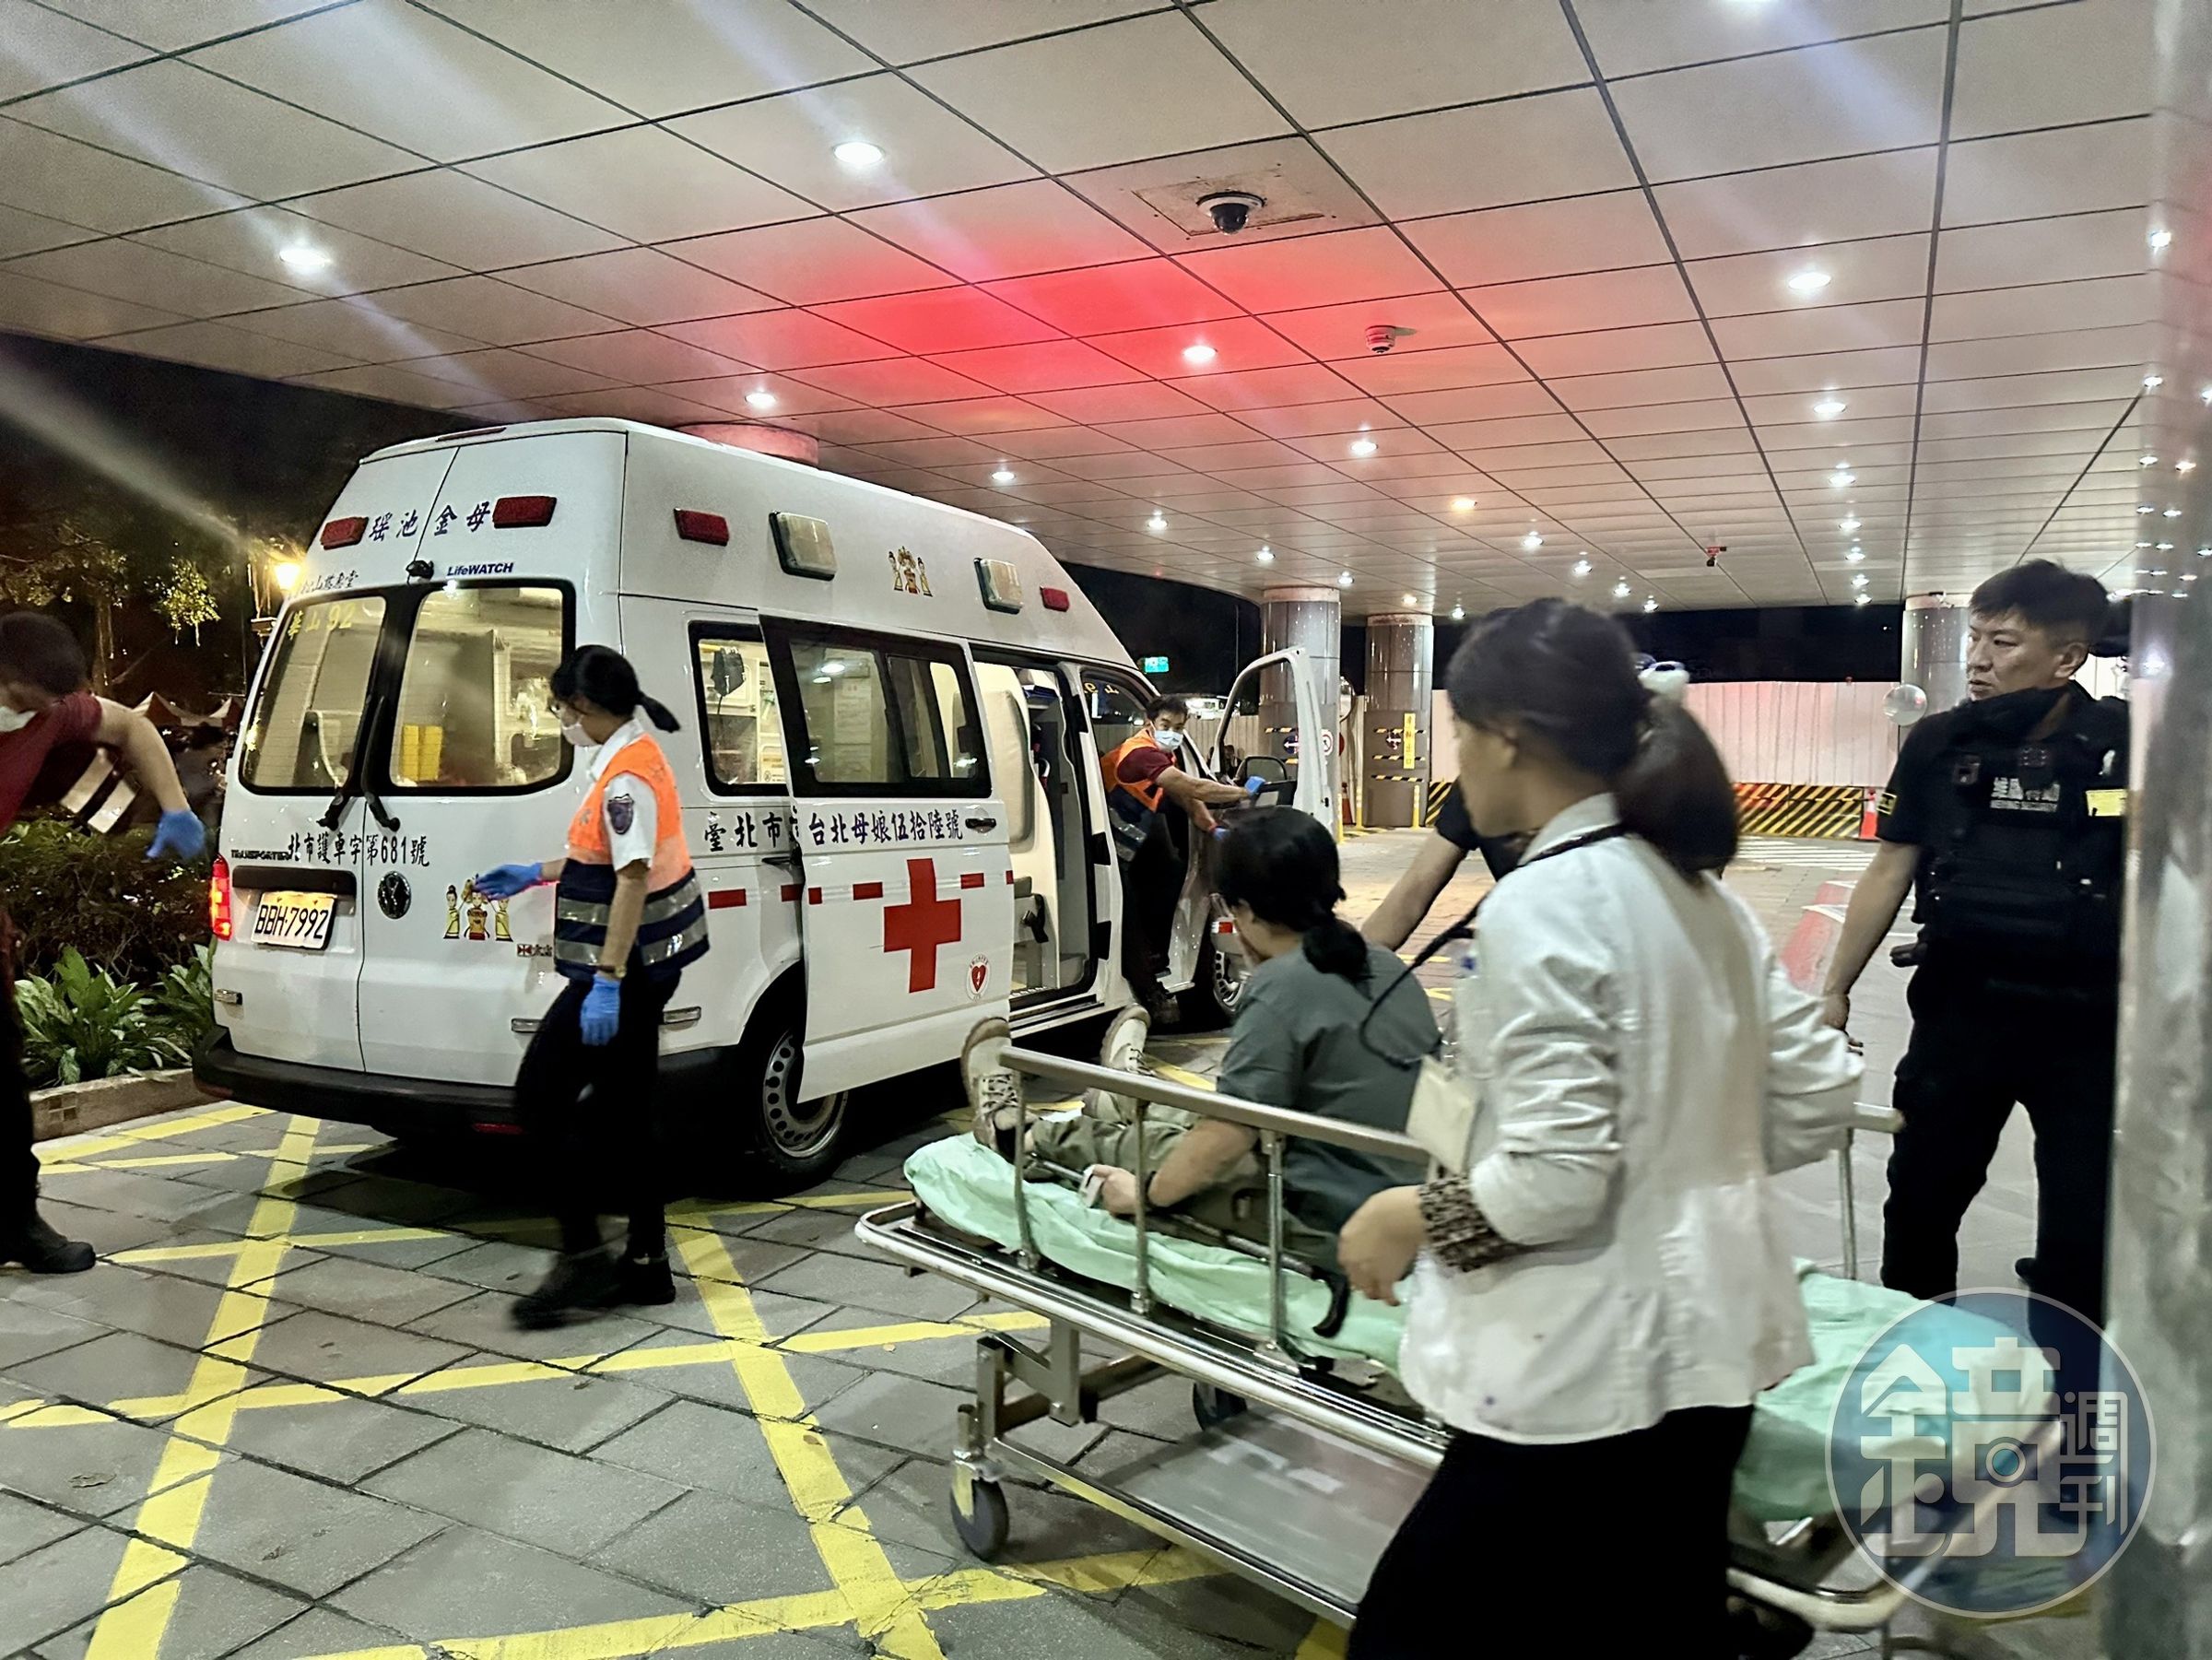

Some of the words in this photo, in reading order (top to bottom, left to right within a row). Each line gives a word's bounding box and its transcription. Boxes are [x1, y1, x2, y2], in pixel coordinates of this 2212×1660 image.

[447, 562, 513, 576] LifeWATCH
[288, 830, 430, 867] 北市護車字第681號
